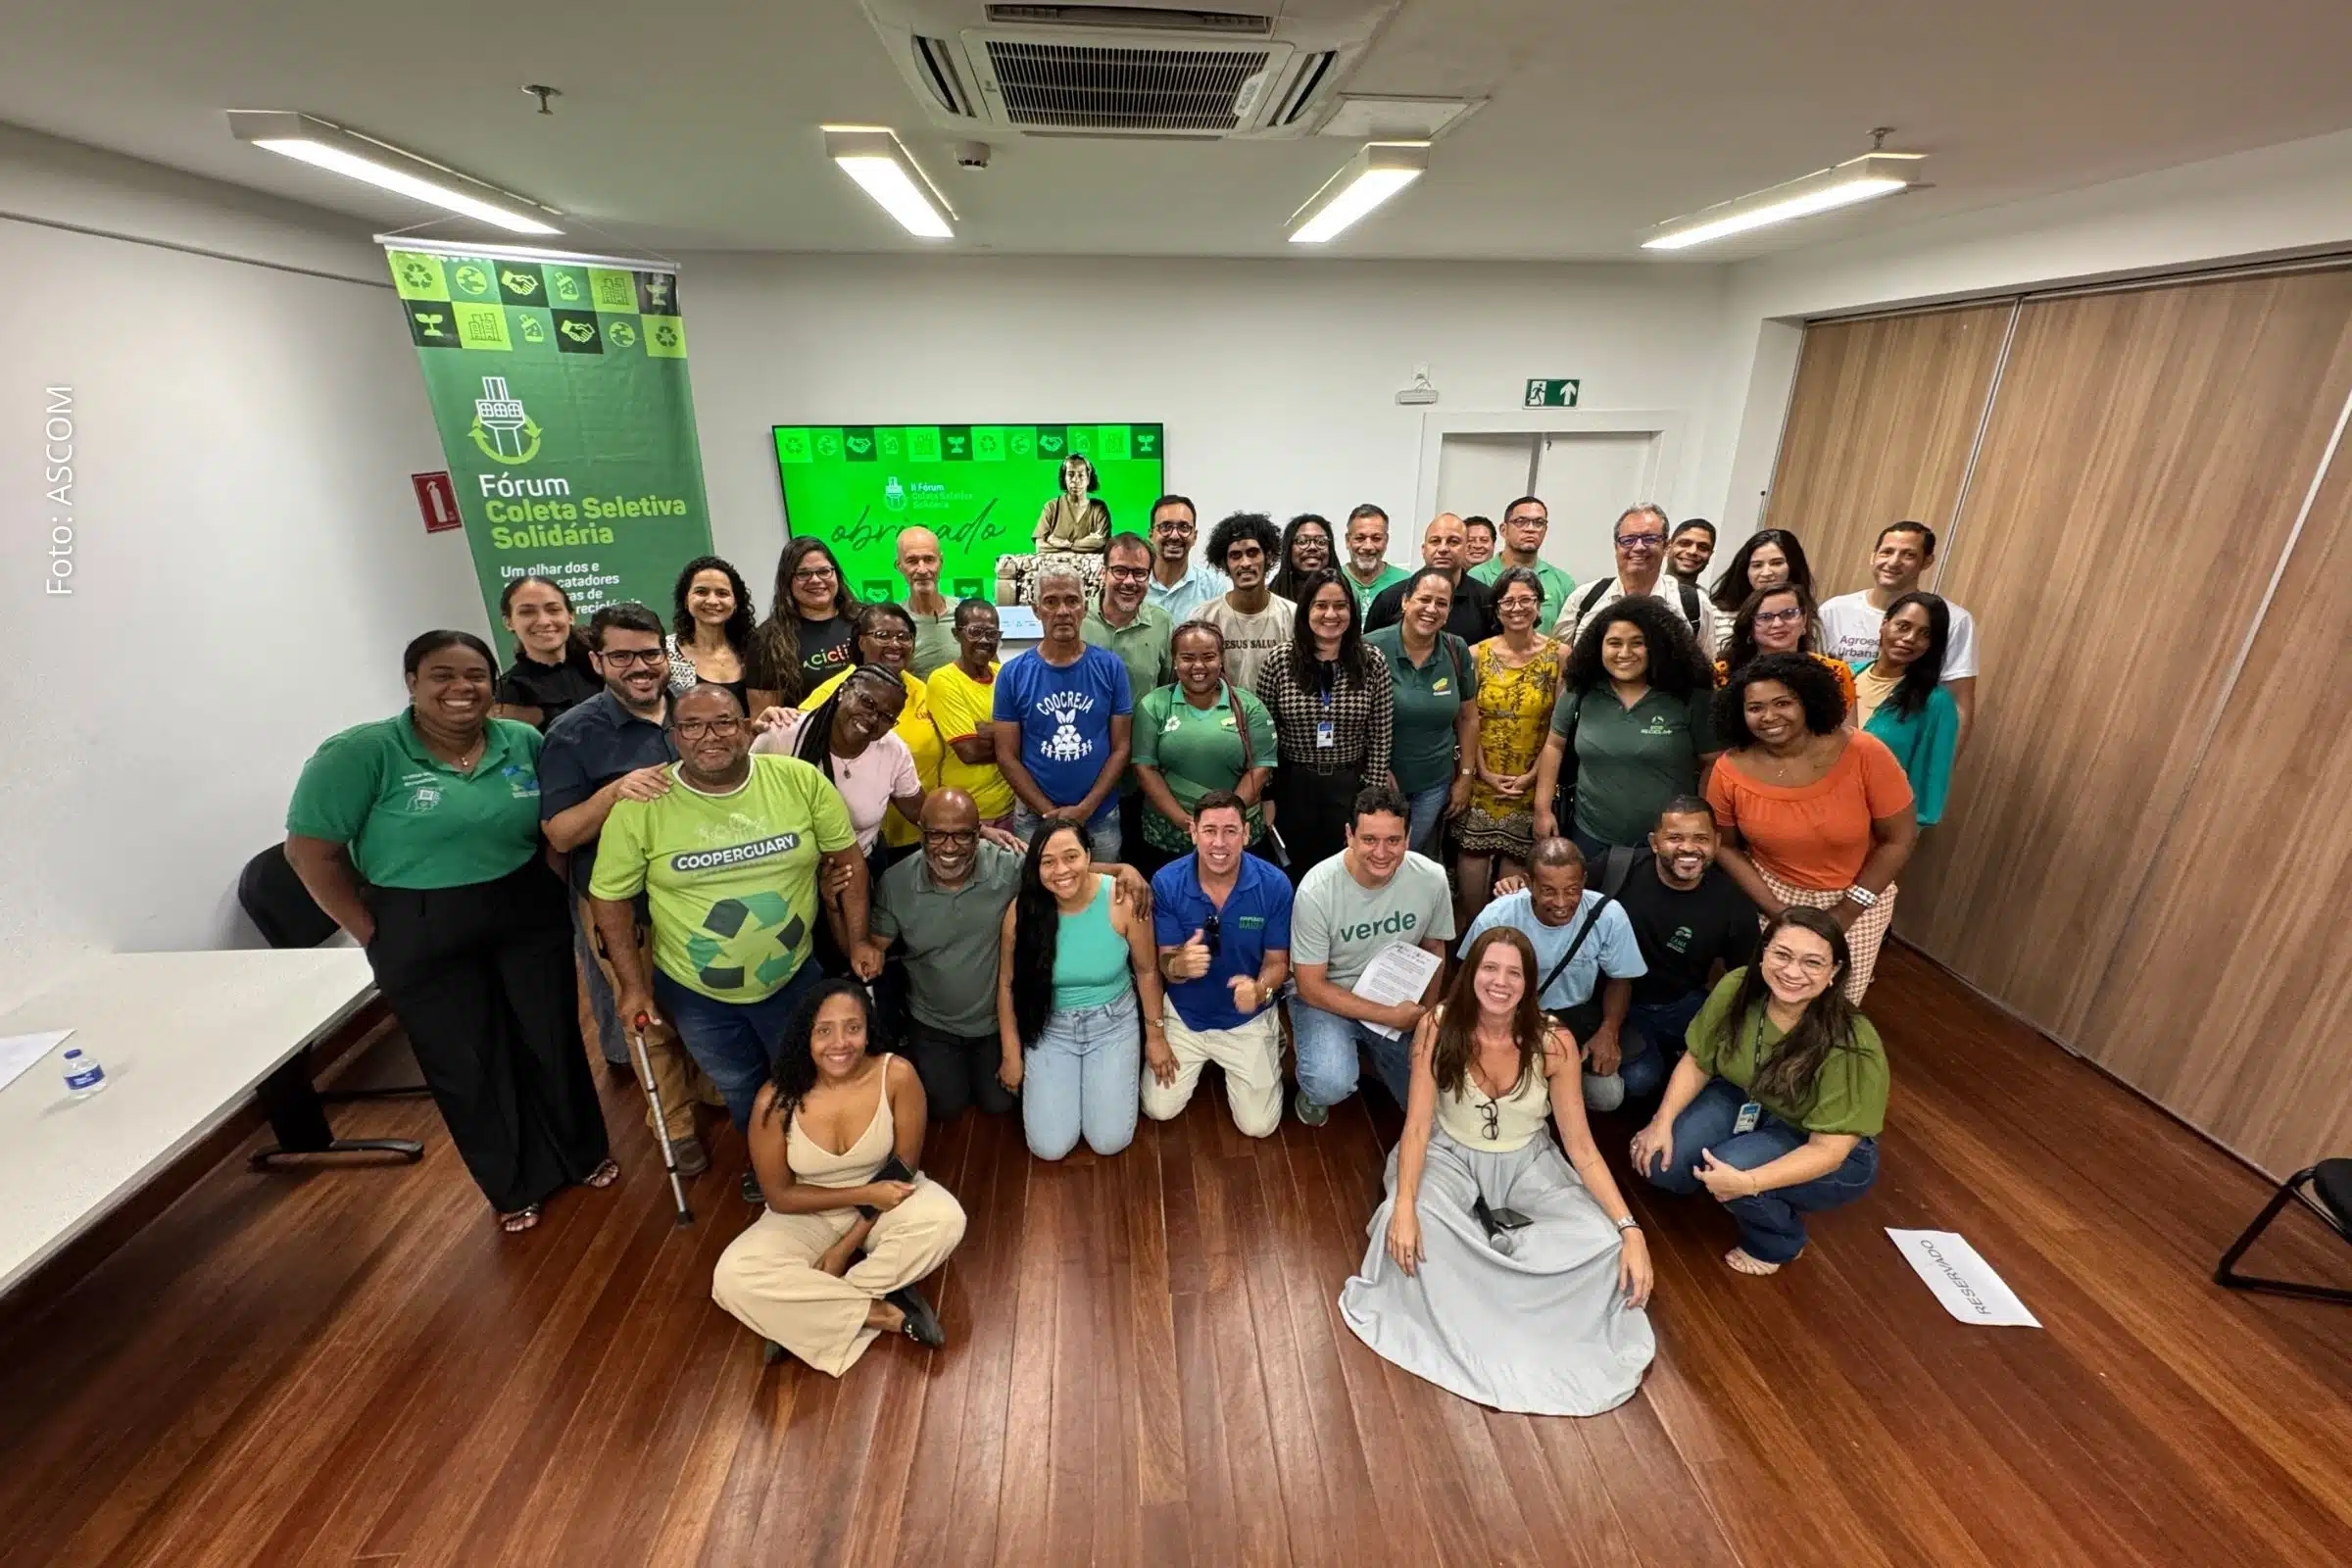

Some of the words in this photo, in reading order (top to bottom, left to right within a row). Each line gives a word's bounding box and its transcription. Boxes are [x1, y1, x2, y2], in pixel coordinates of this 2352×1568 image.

[478, 471, 570, 498] Fórum
[485, 498, 577, 523] Coleta
[581, 495, 687, 519] Seletiva
[491, 521, 614, 550] Solidária
[831, 498, 1007, 555] obrado
[501, 565, 525, 578] Um
[527, 564, 563, 577] olhar
[564, 562, 589, 574] dos
[591, 563, 600, 572] e
[557, 574, 620, 589] catadores
[587, 589, 604, 601] de
[1223, 639, 1249, 649] ESUS
[1036, 690, 1095, 716] COOCREJA
[676, 834, 796, 870] COOPERGUARY
[1340, 910, 1417, 943] verde
[1920, 1239, 1992, 1315] RESERVADO
